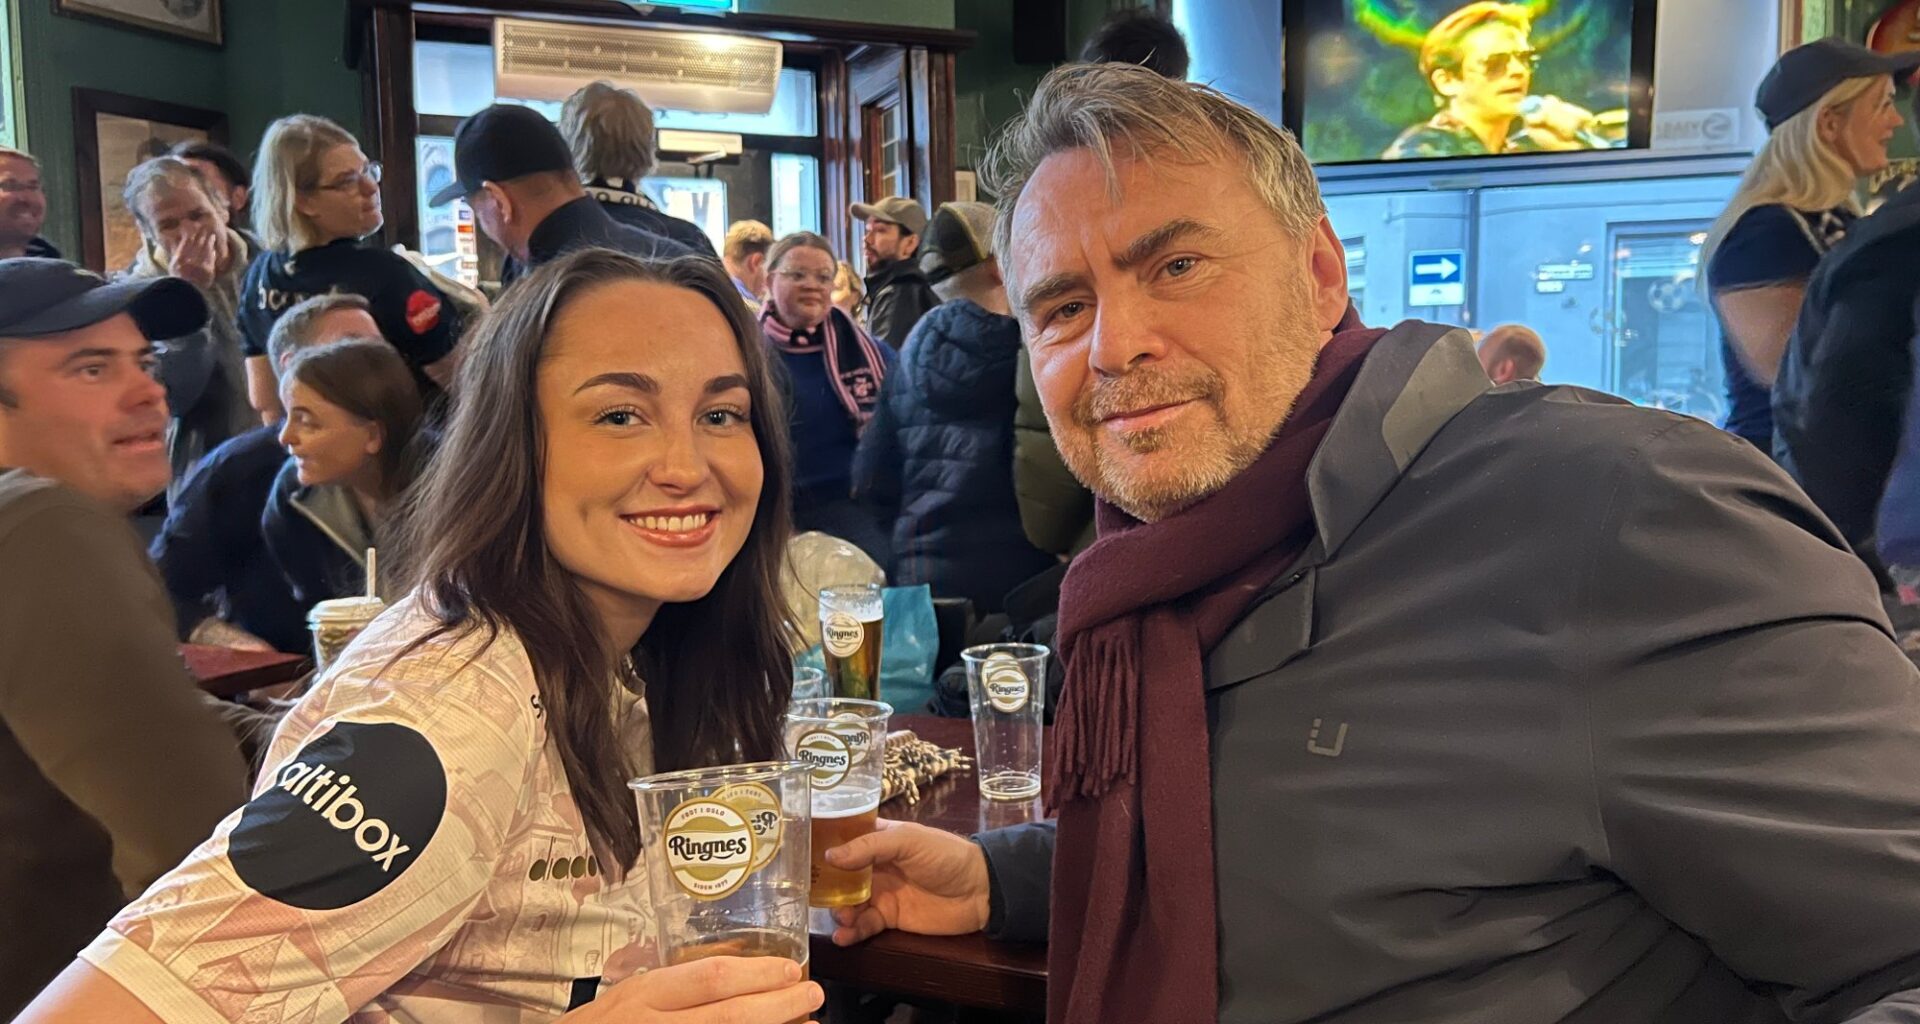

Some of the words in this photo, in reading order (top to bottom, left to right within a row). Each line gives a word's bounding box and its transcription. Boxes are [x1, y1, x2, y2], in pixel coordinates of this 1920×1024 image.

[825, 627, 859, 640] Ringnes
[798, 749, 847, 768] Ringnes
[278, 761, 411, 872] altibox
[705, 807, 726, 817] OSLO
[668, 835, 747, 861] Ringnes
